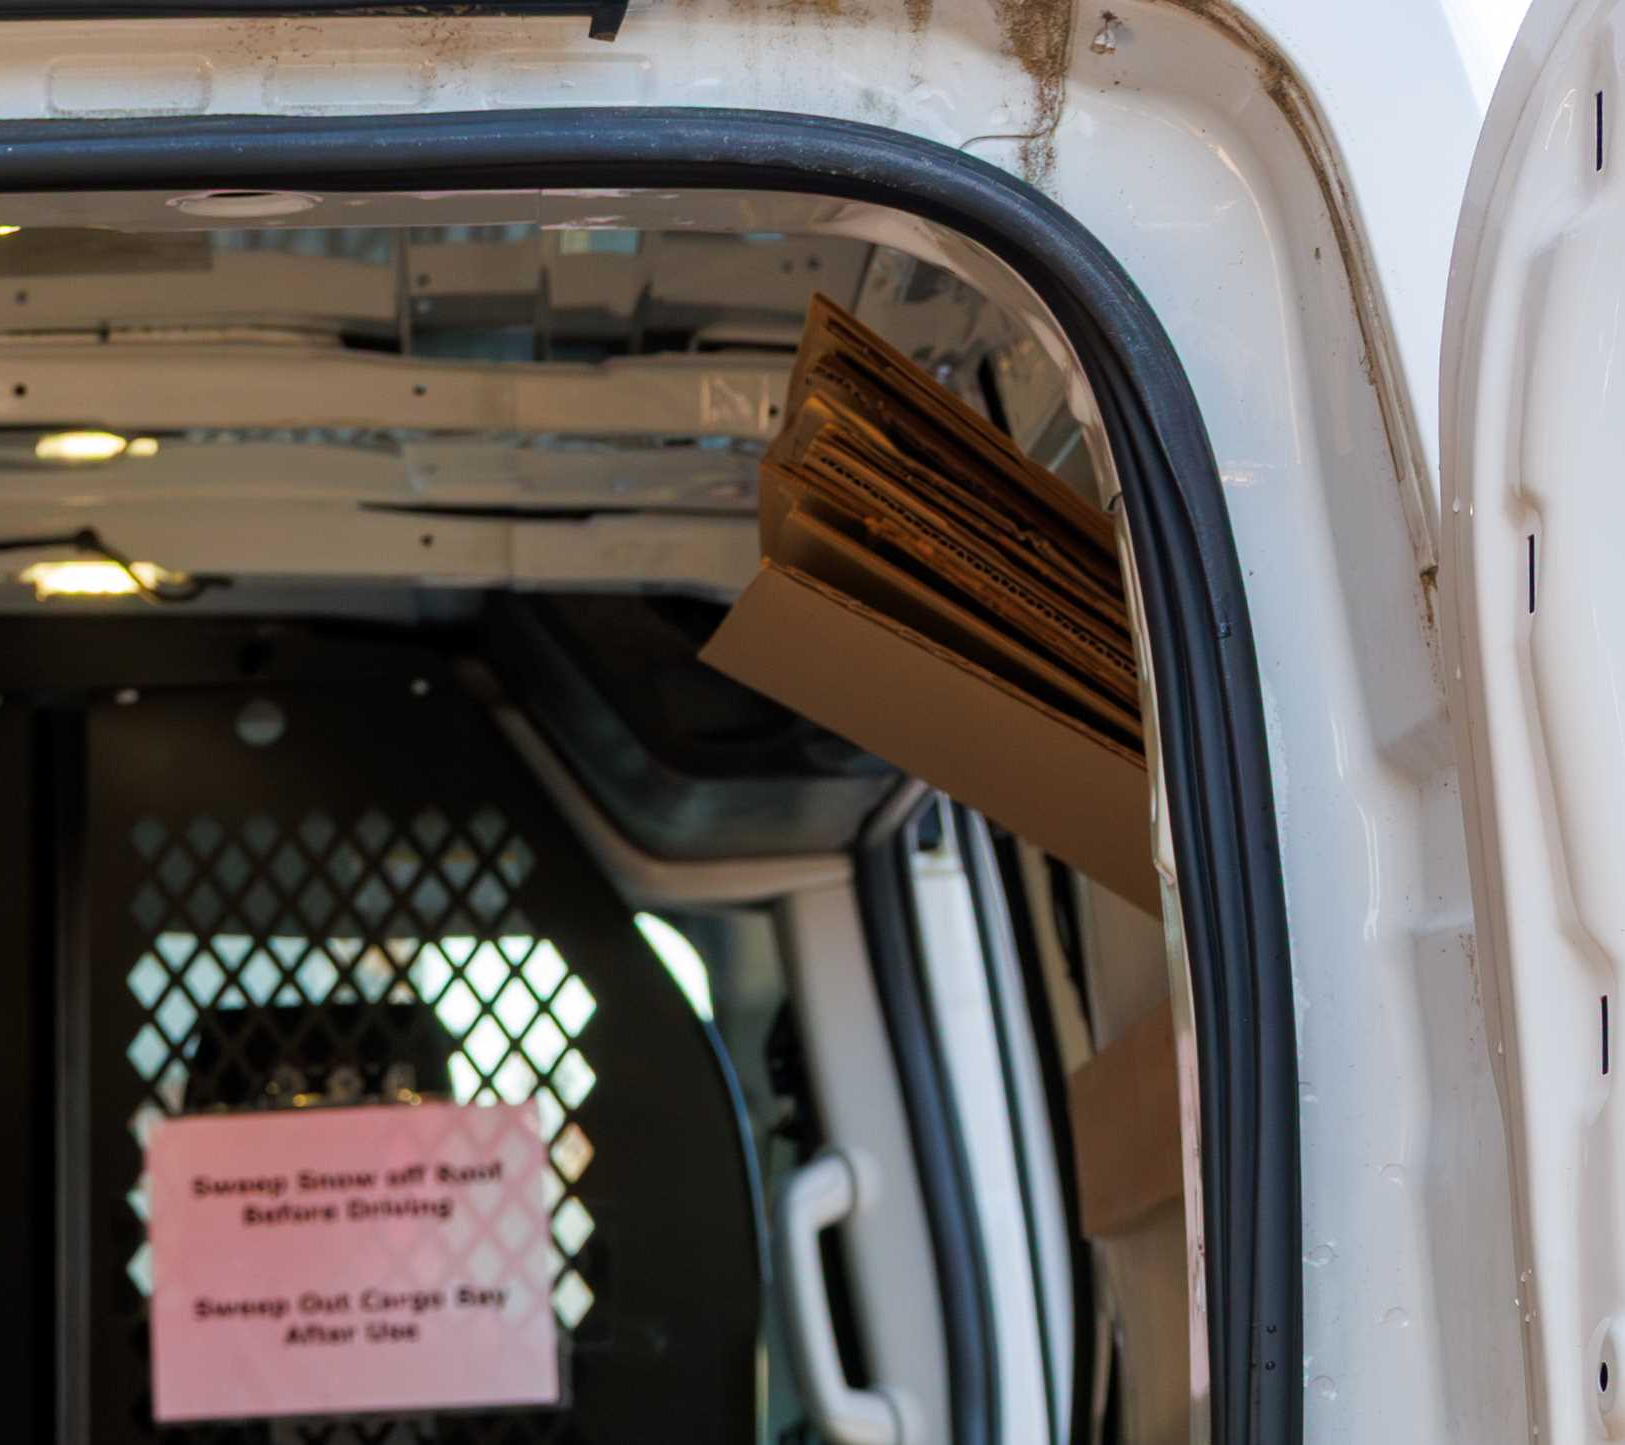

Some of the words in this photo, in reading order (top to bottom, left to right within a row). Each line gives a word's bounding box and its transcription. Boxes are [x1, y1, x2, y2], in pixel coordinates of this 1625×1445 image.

[193, 1174, 286, 1198] Sweep
[297, 1167, 373, 1192] Snow
[385, 1164, 425, 1187] off
[435, 1160, 503, 1185] Roof
[243, 1201, 338, 1226] Before
[347, 1198, 453, 1223] Driving
[195, 1297, 288, 1321] Sweep
[299, 1290, 349, 1313] Out
[359, 1288, 443, 1315] Cargo
[455, 1285, 507, 1308] Bay
[285, 1323, 355, 1345] After
[365, 1321, 418, 1342] Use
